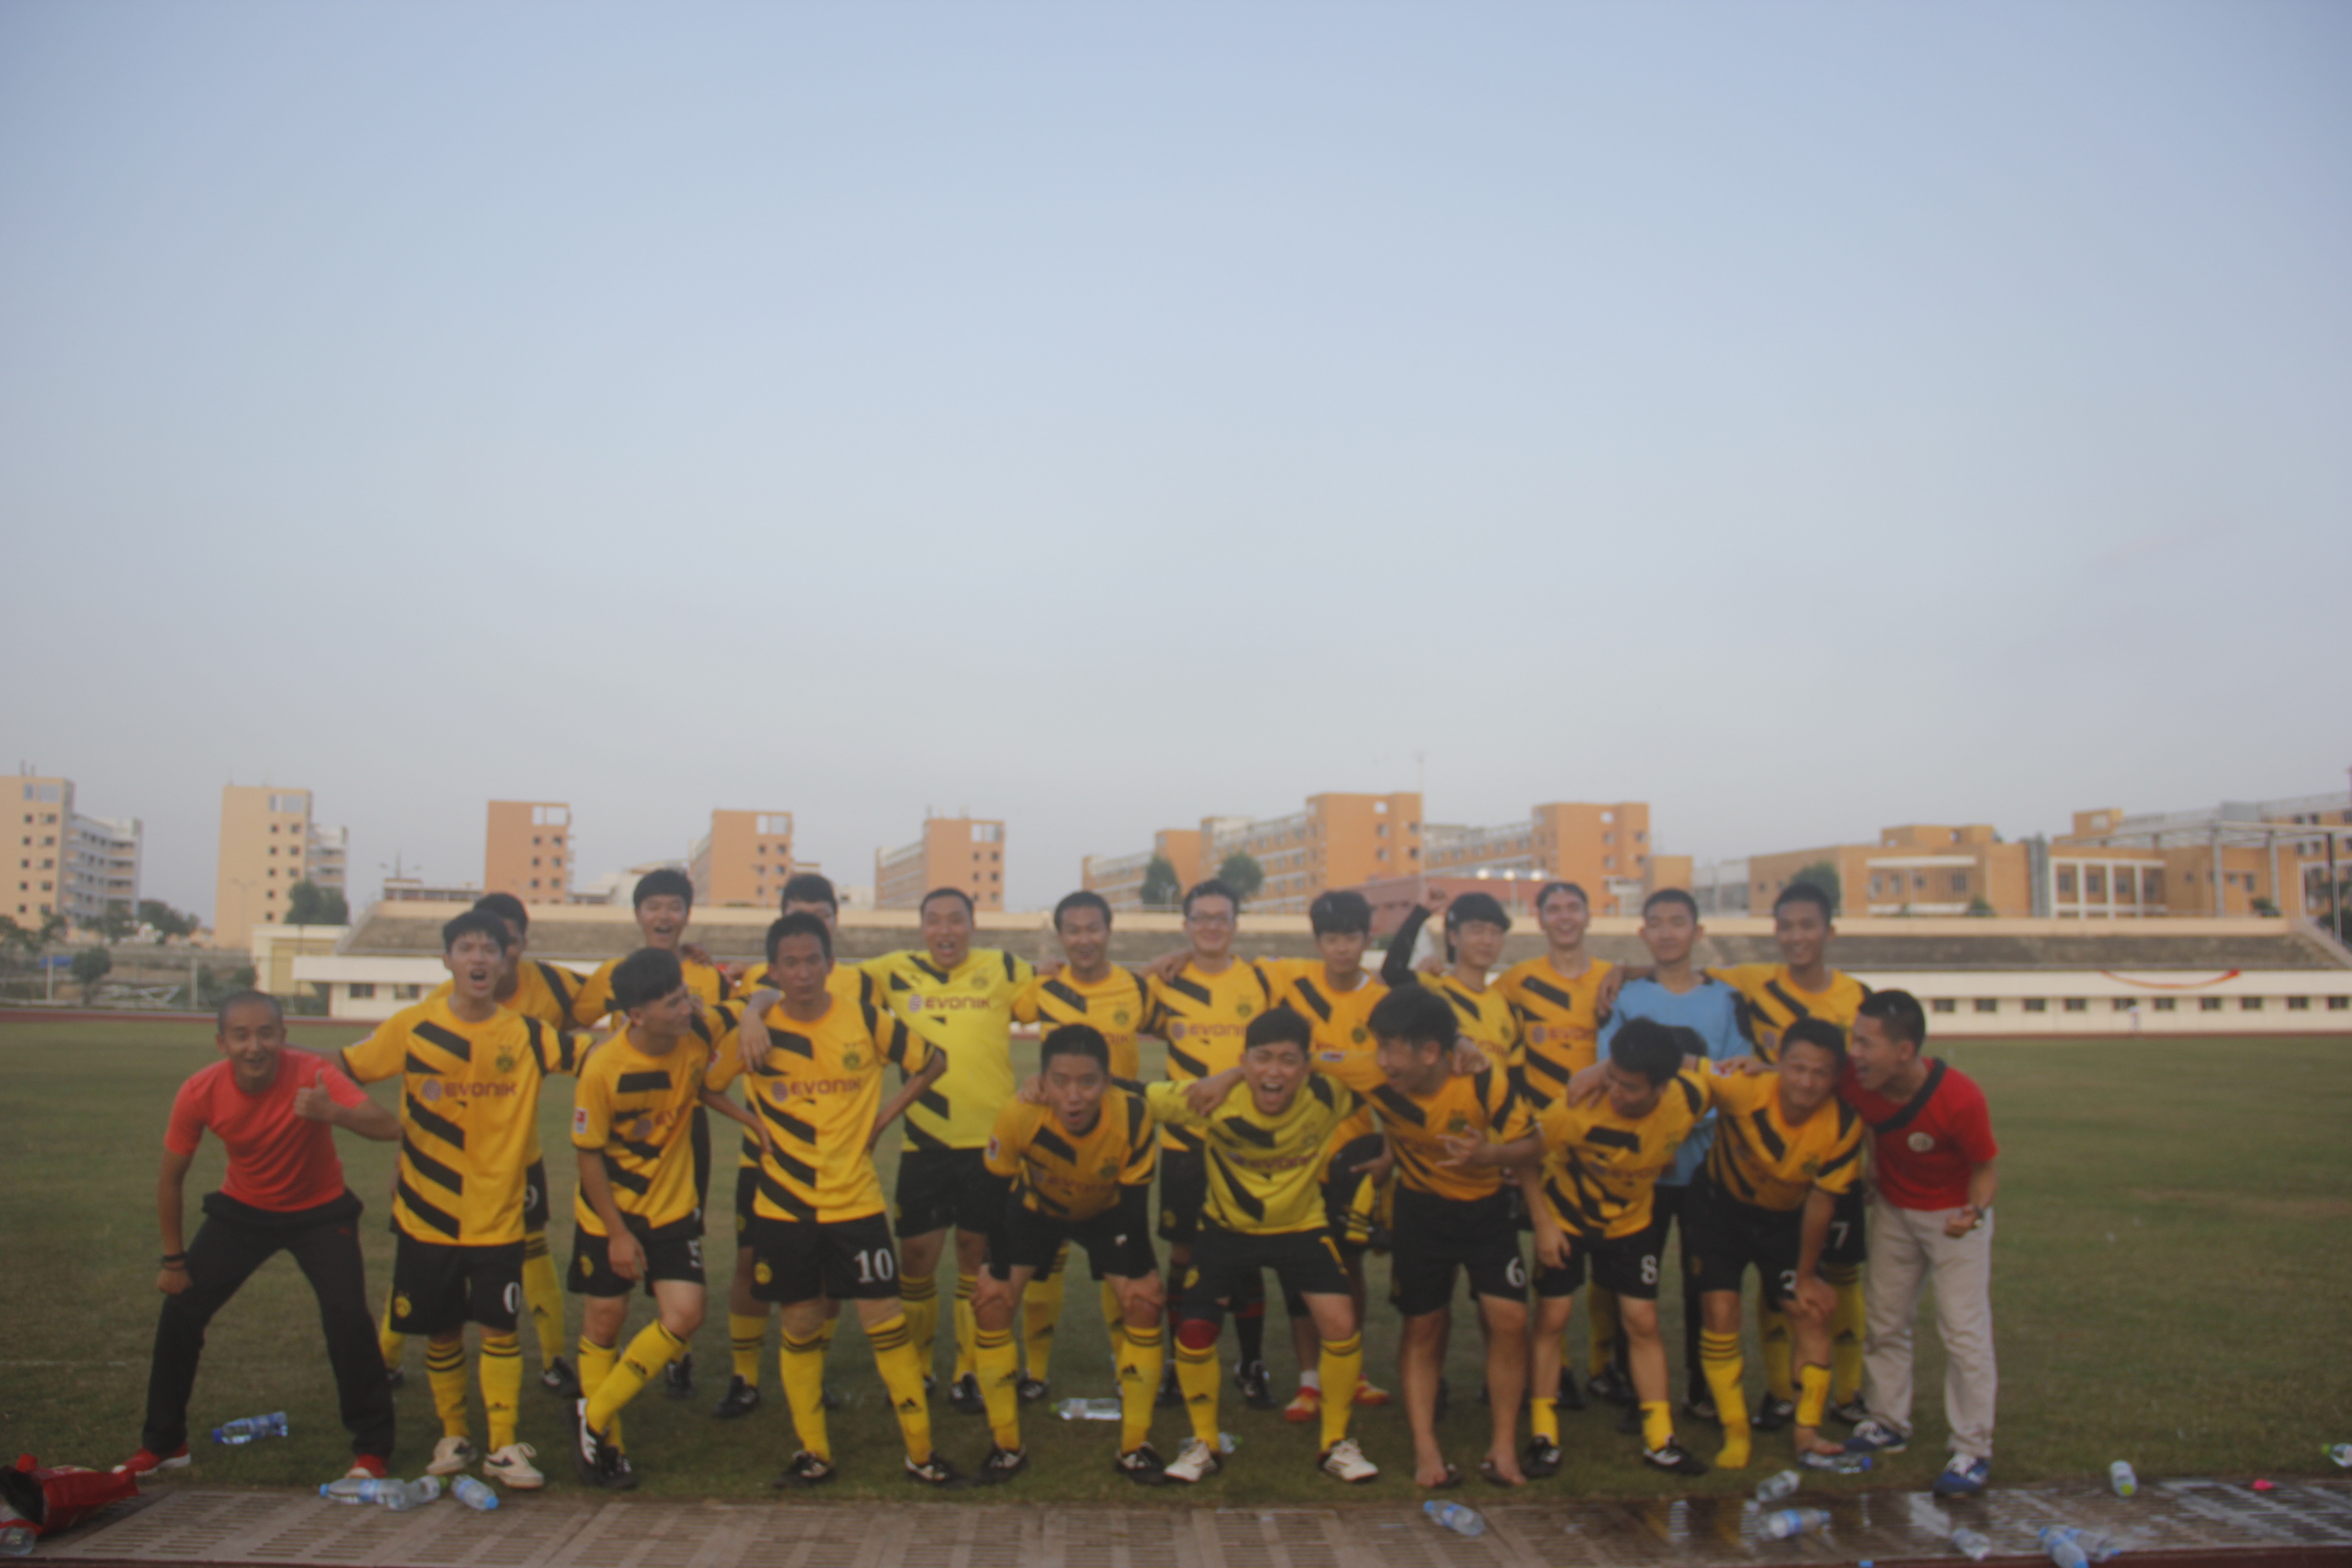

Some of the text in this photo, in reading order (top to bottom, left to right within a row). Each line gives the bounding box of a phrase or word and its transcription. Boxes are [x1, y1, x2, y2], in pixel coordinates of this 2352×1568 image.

[1189, 1023, 1248, 1037] EVONI
[853, 1248, 894, 1284] 10
[1505, 1256, 1525, 1288] 6
[1641, 1254, 1657, 1285] 8
